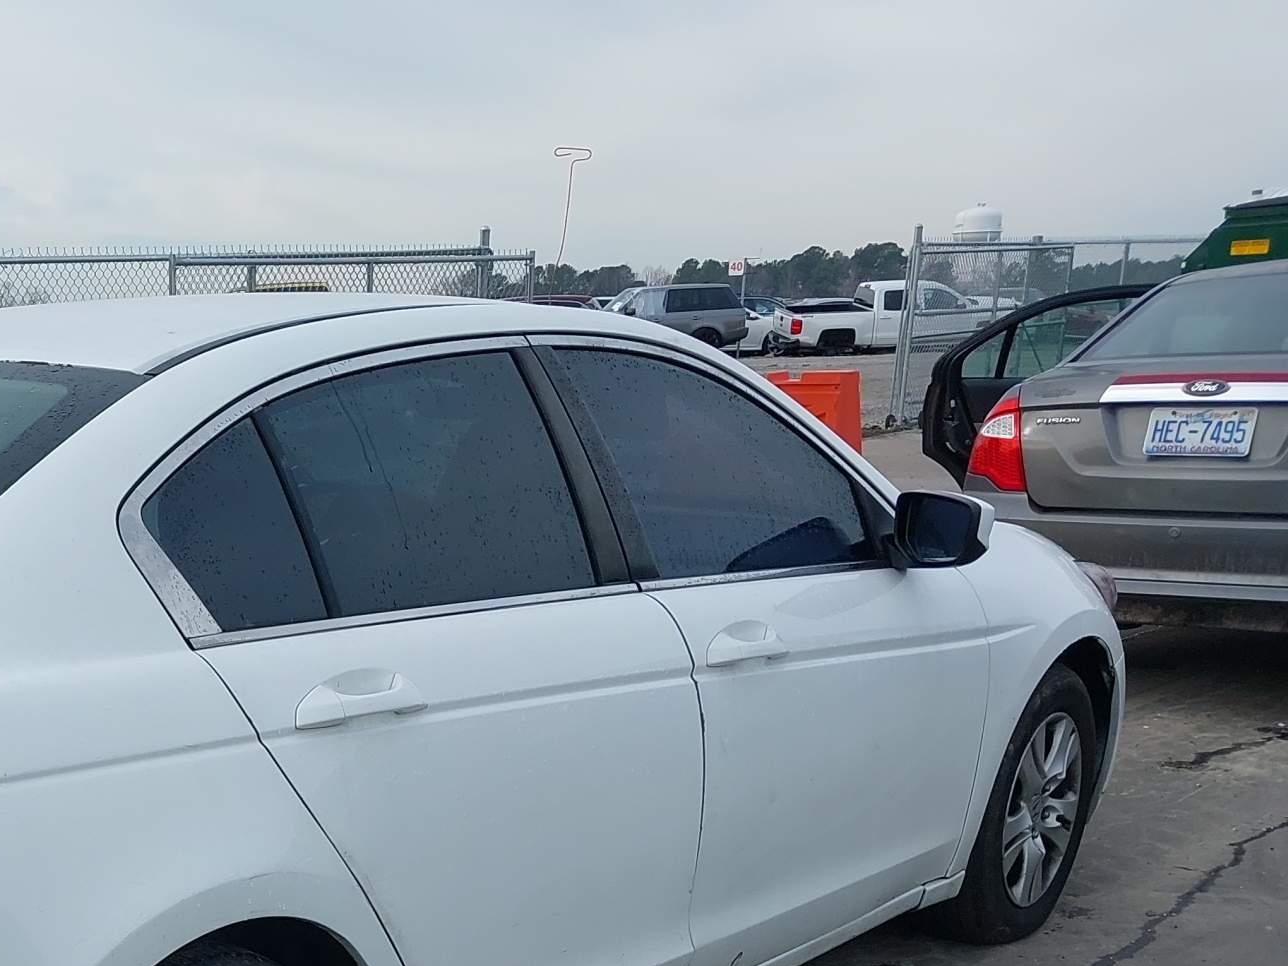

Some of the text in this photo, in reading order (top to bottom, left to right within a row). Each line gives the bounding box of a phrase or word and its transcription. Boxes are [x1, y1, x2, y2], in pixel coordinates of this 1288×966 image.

[730, 261, 743, 272] 40
[1191, 381, 1220, 392] Ford
[1035, 416, 1081, 425] FUSION
[1151, 419, 1249, 444] HEC-7495
